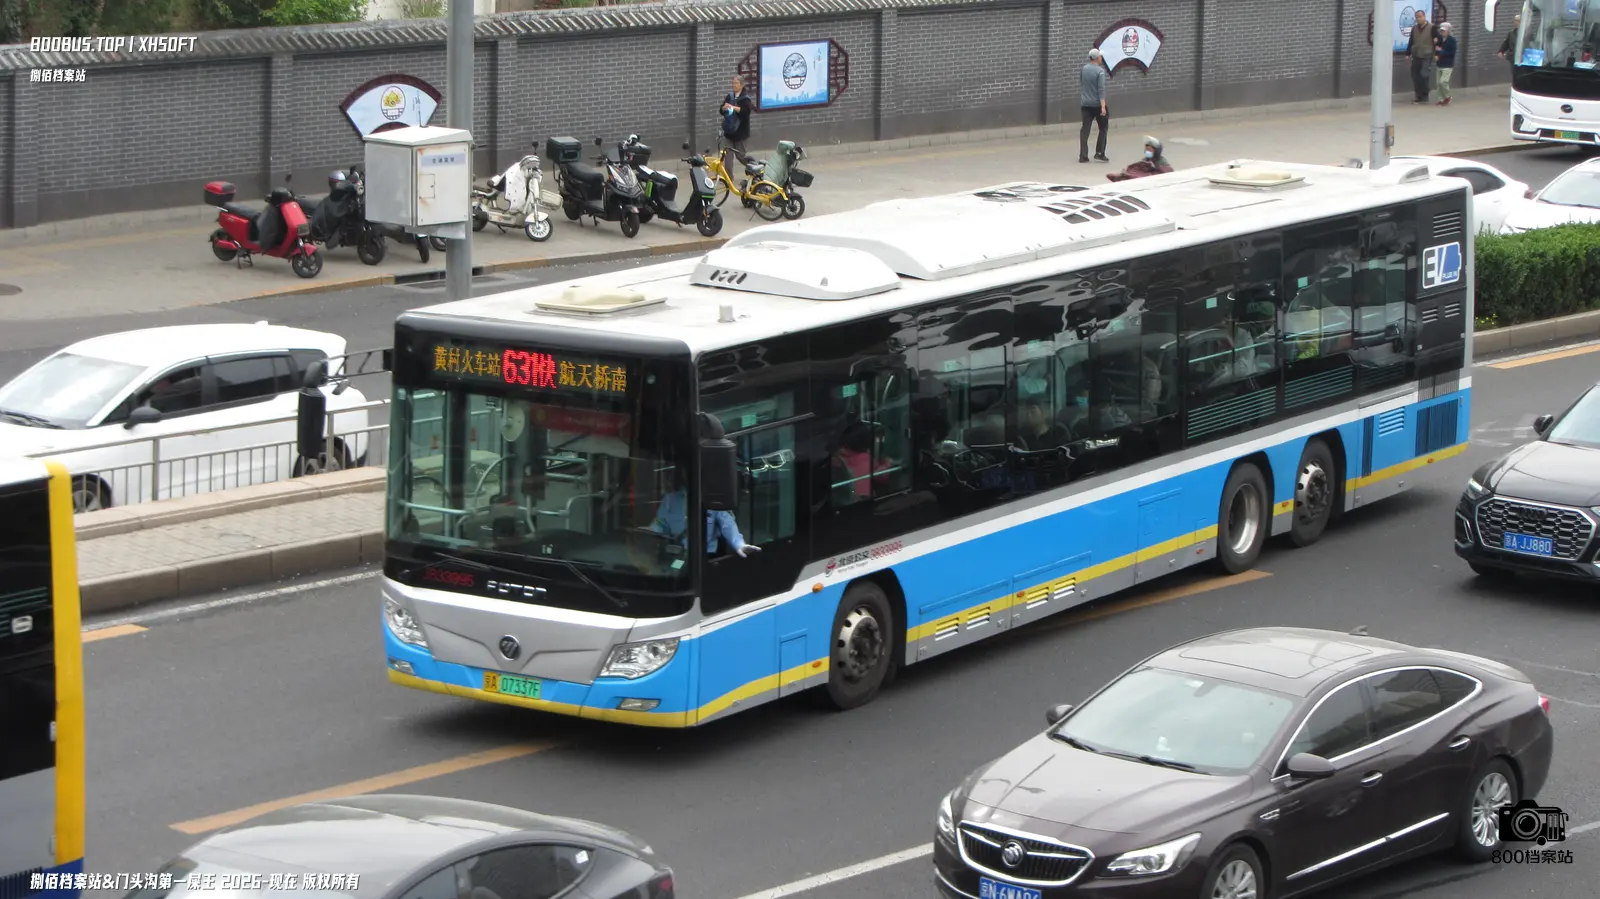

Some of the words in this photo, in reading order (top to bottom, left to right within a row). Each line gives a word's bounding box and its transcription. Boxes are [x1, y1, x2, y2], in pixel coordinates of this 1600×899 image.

[434, 346, 500, 377] 黄村火车站
[559, 361, 627, 392] 航天桥南
[487, 580, 547, 599] FOTON
